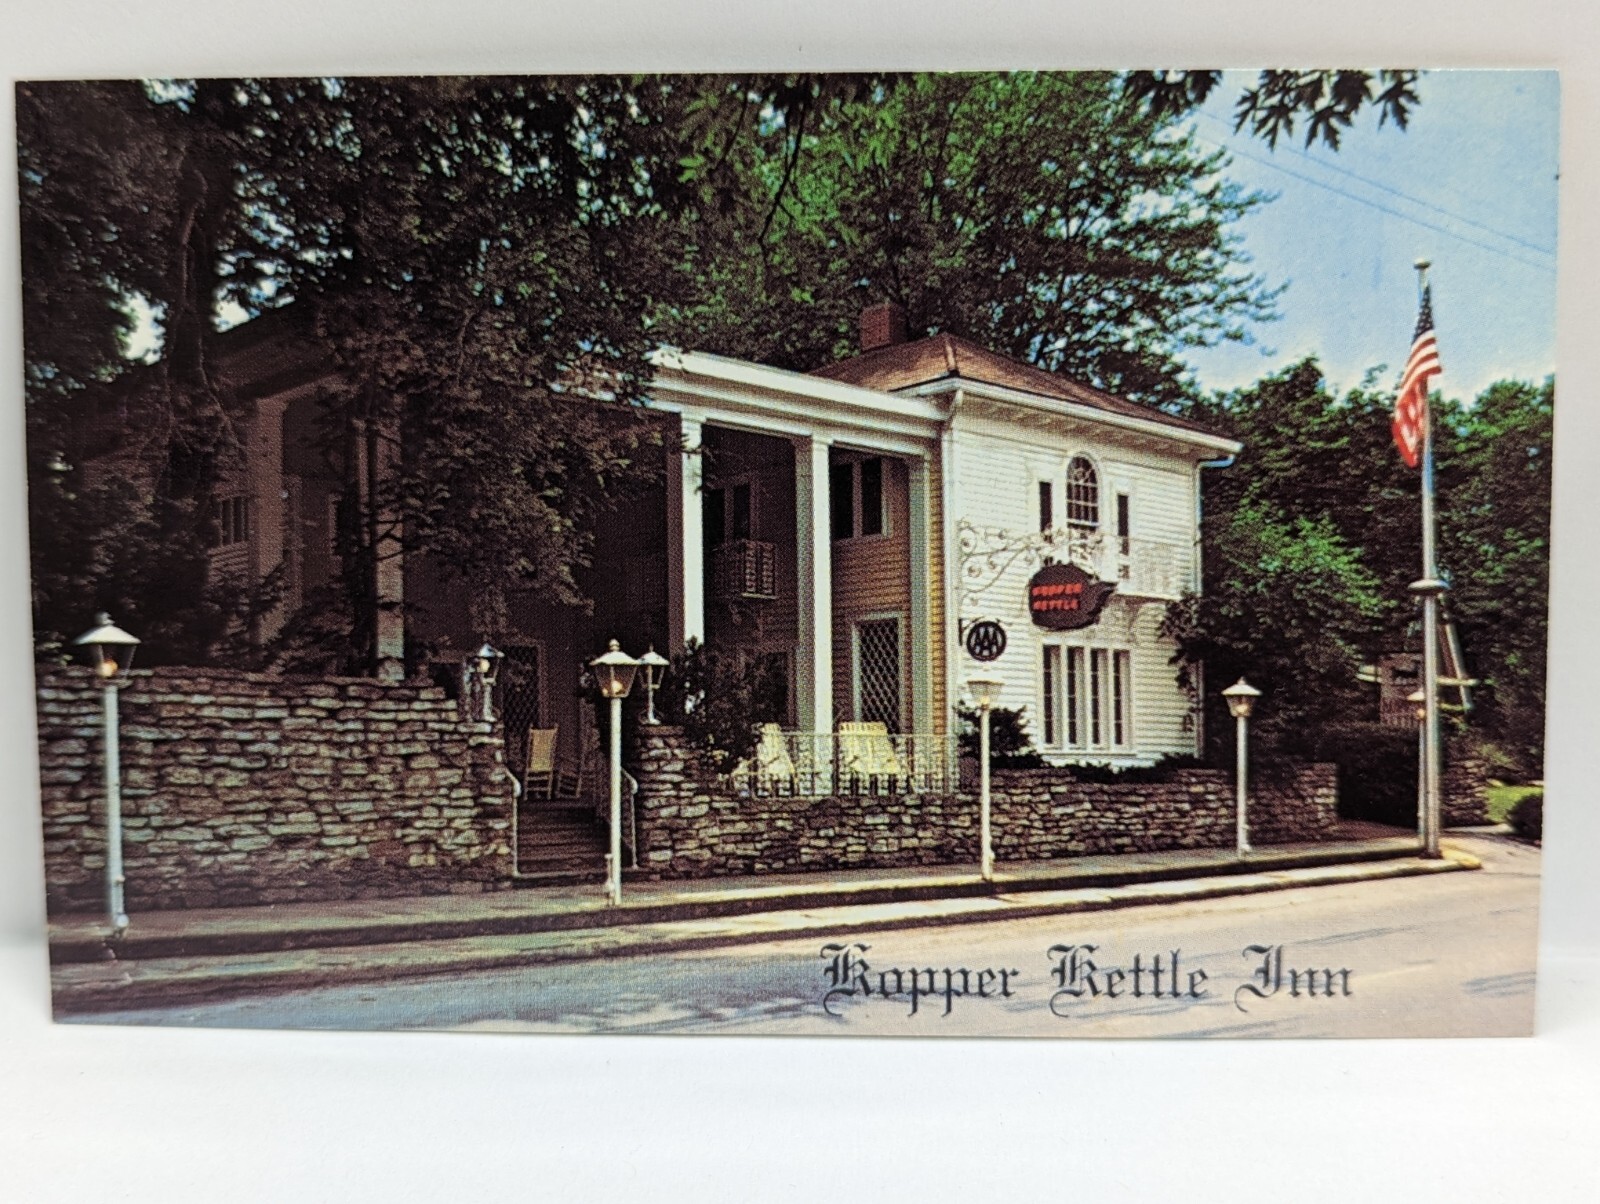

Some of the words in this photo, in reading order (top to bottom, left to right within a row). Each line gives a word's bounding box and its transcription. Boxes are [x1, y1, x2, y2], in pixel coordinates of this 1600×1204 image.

[969, 624, 1004, 658] AAA
[820, 943, 1020, 1018] Kopper
[1047, 943, 1210, 1018] Kettle
[1233, 943, 1355, 1014] Inn
